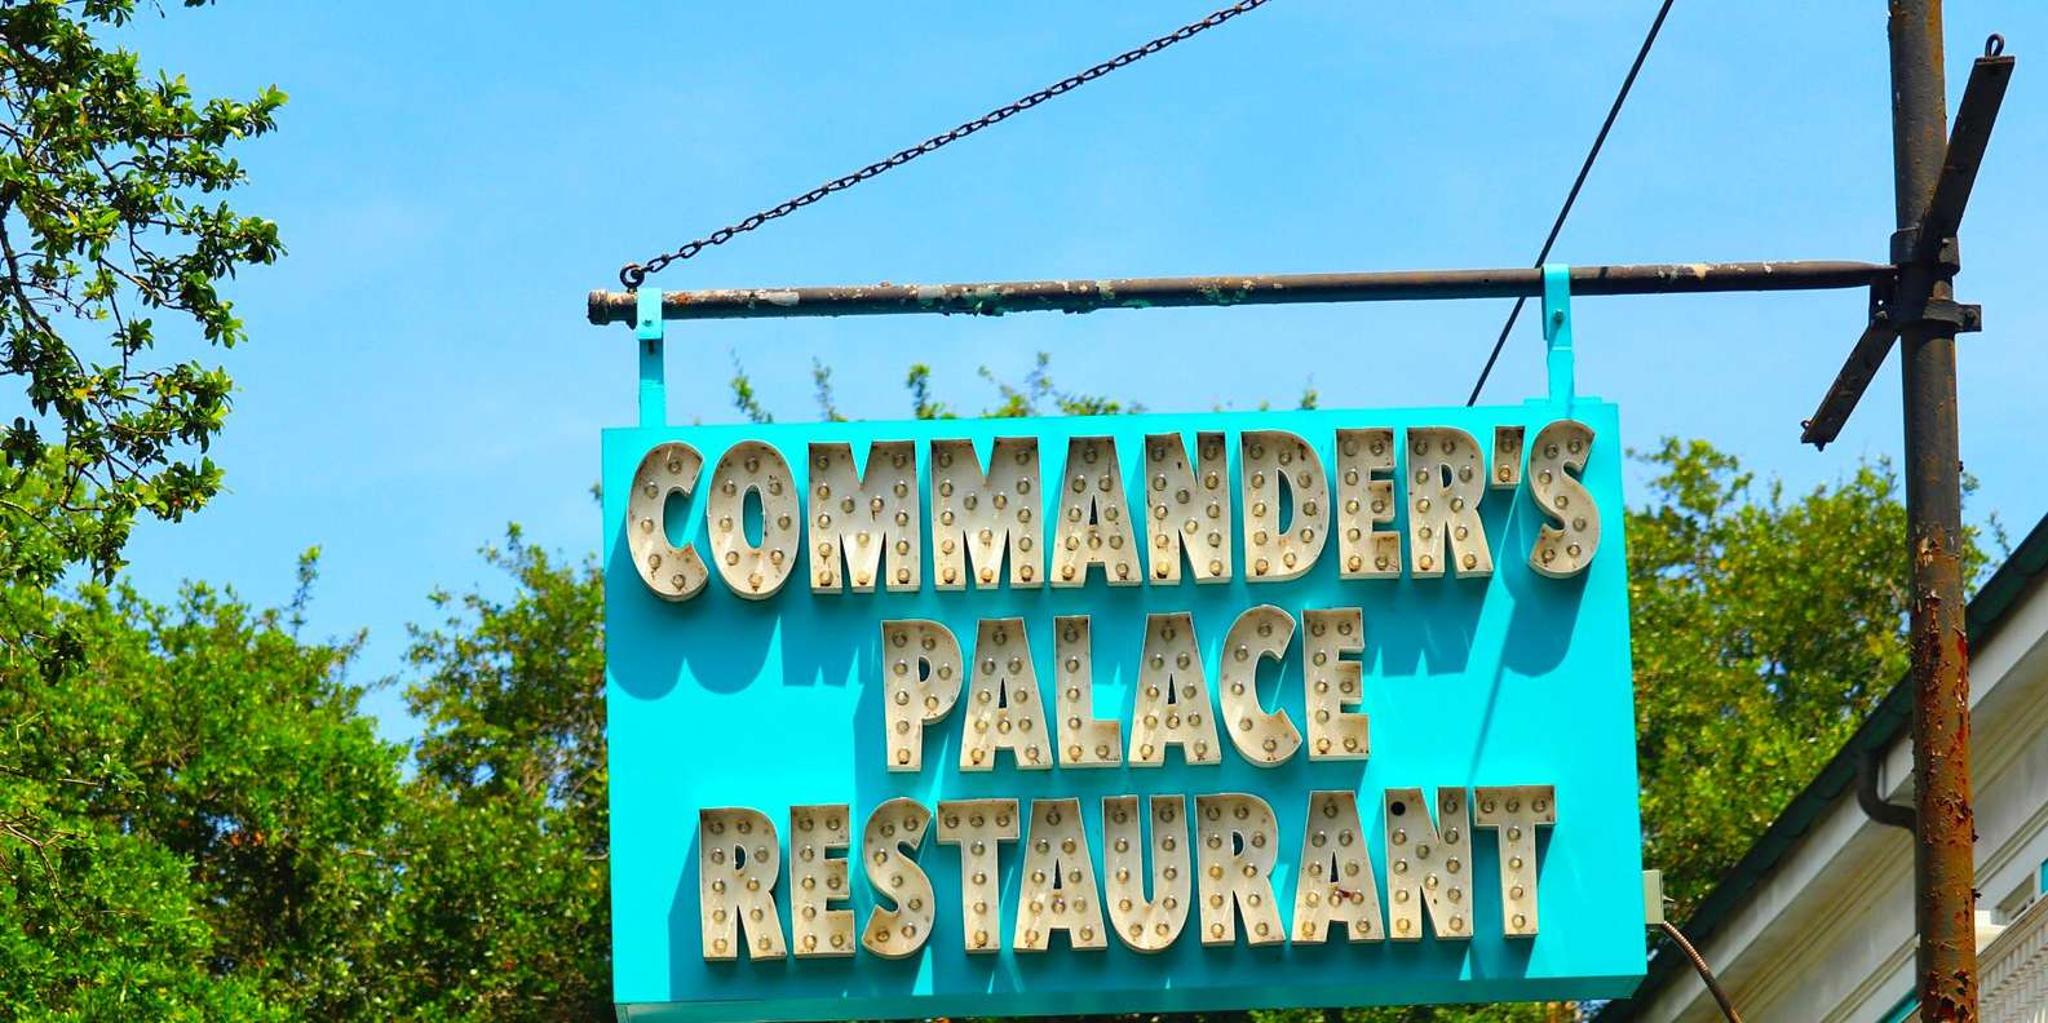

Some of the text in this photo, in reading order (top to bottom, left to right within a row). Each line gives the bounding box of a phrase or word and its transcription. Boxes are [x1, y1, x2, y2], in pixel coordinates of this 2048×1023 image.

[626, 419, 1601, 601] COMMANDER'S
[881, 604, 1370, 772] PALACE
[699, 785, 1557, 961] RESTAURANT
